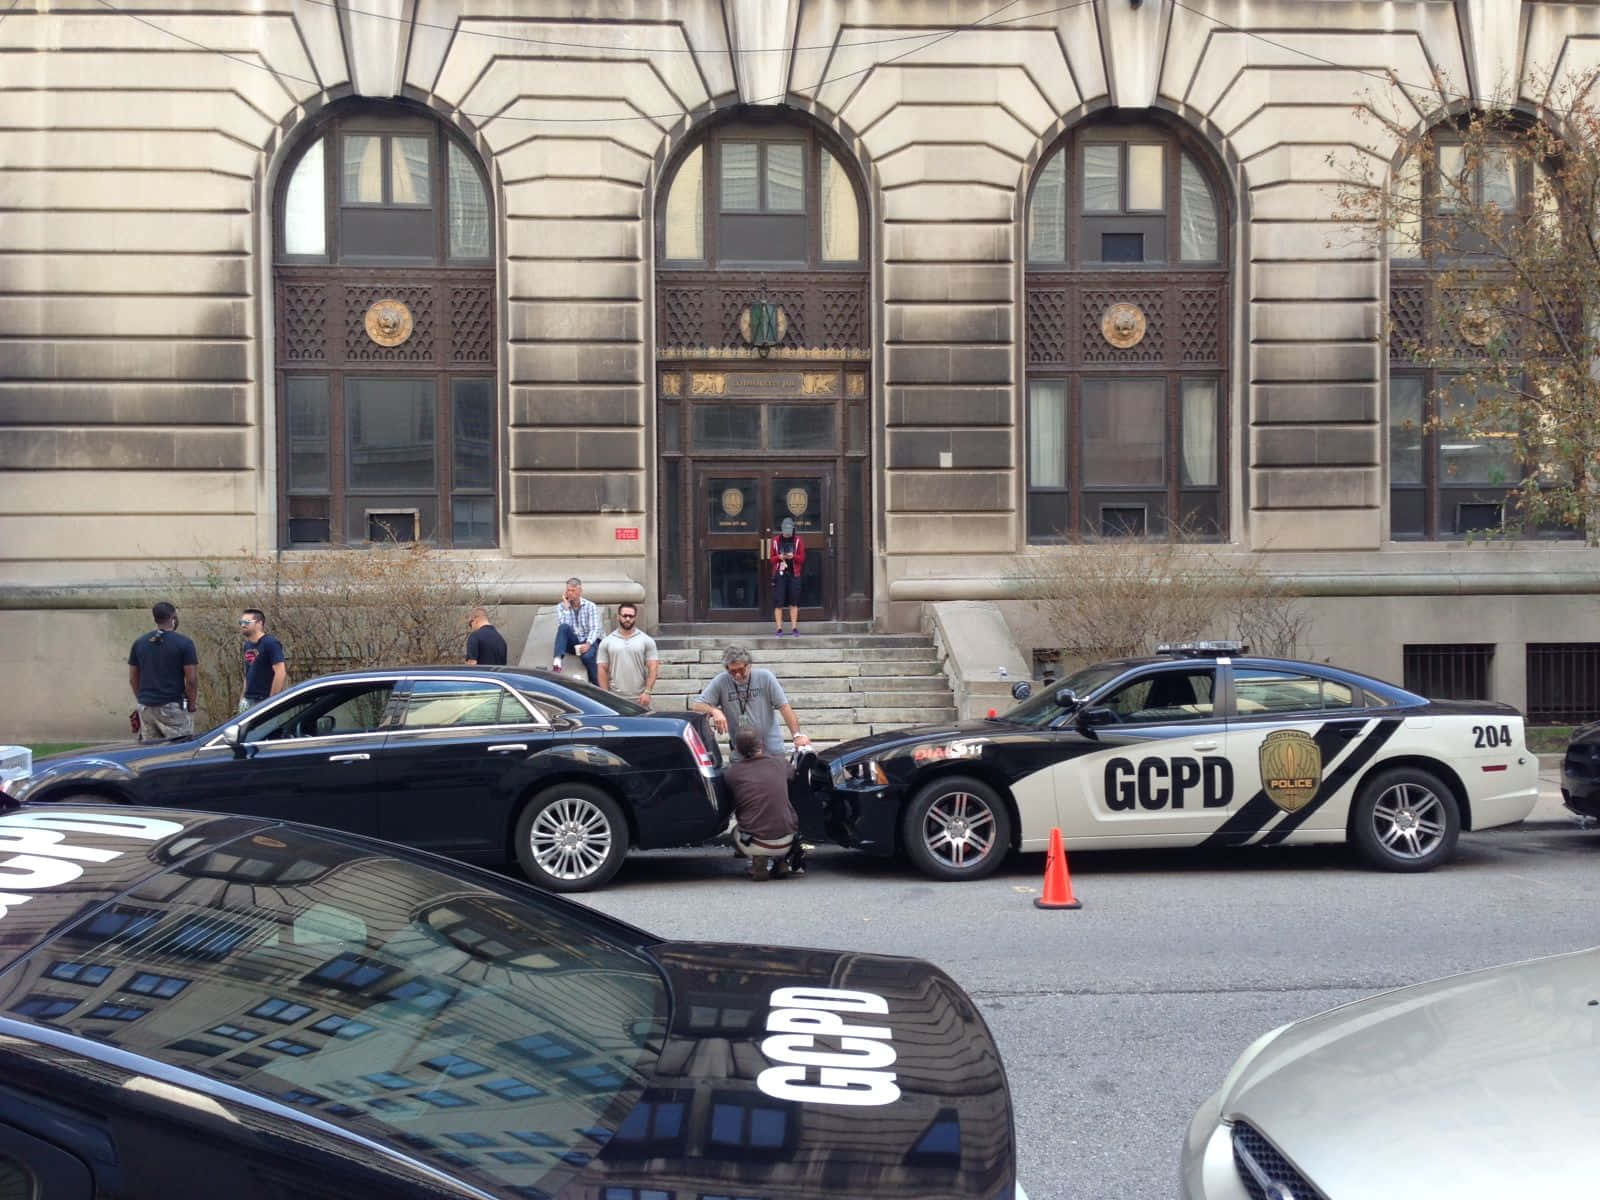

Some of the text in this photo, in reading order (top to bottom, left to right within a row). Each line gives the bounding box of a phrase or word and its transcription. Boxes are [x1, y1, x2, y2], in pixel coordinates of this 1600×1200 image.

[1472, 725, 1512, 748] 204
[1105, 757, 1234, 811] GCPD
[1272, 779, 1312, 789] POLICE
[757, 987, 901, 1106] GCPD
